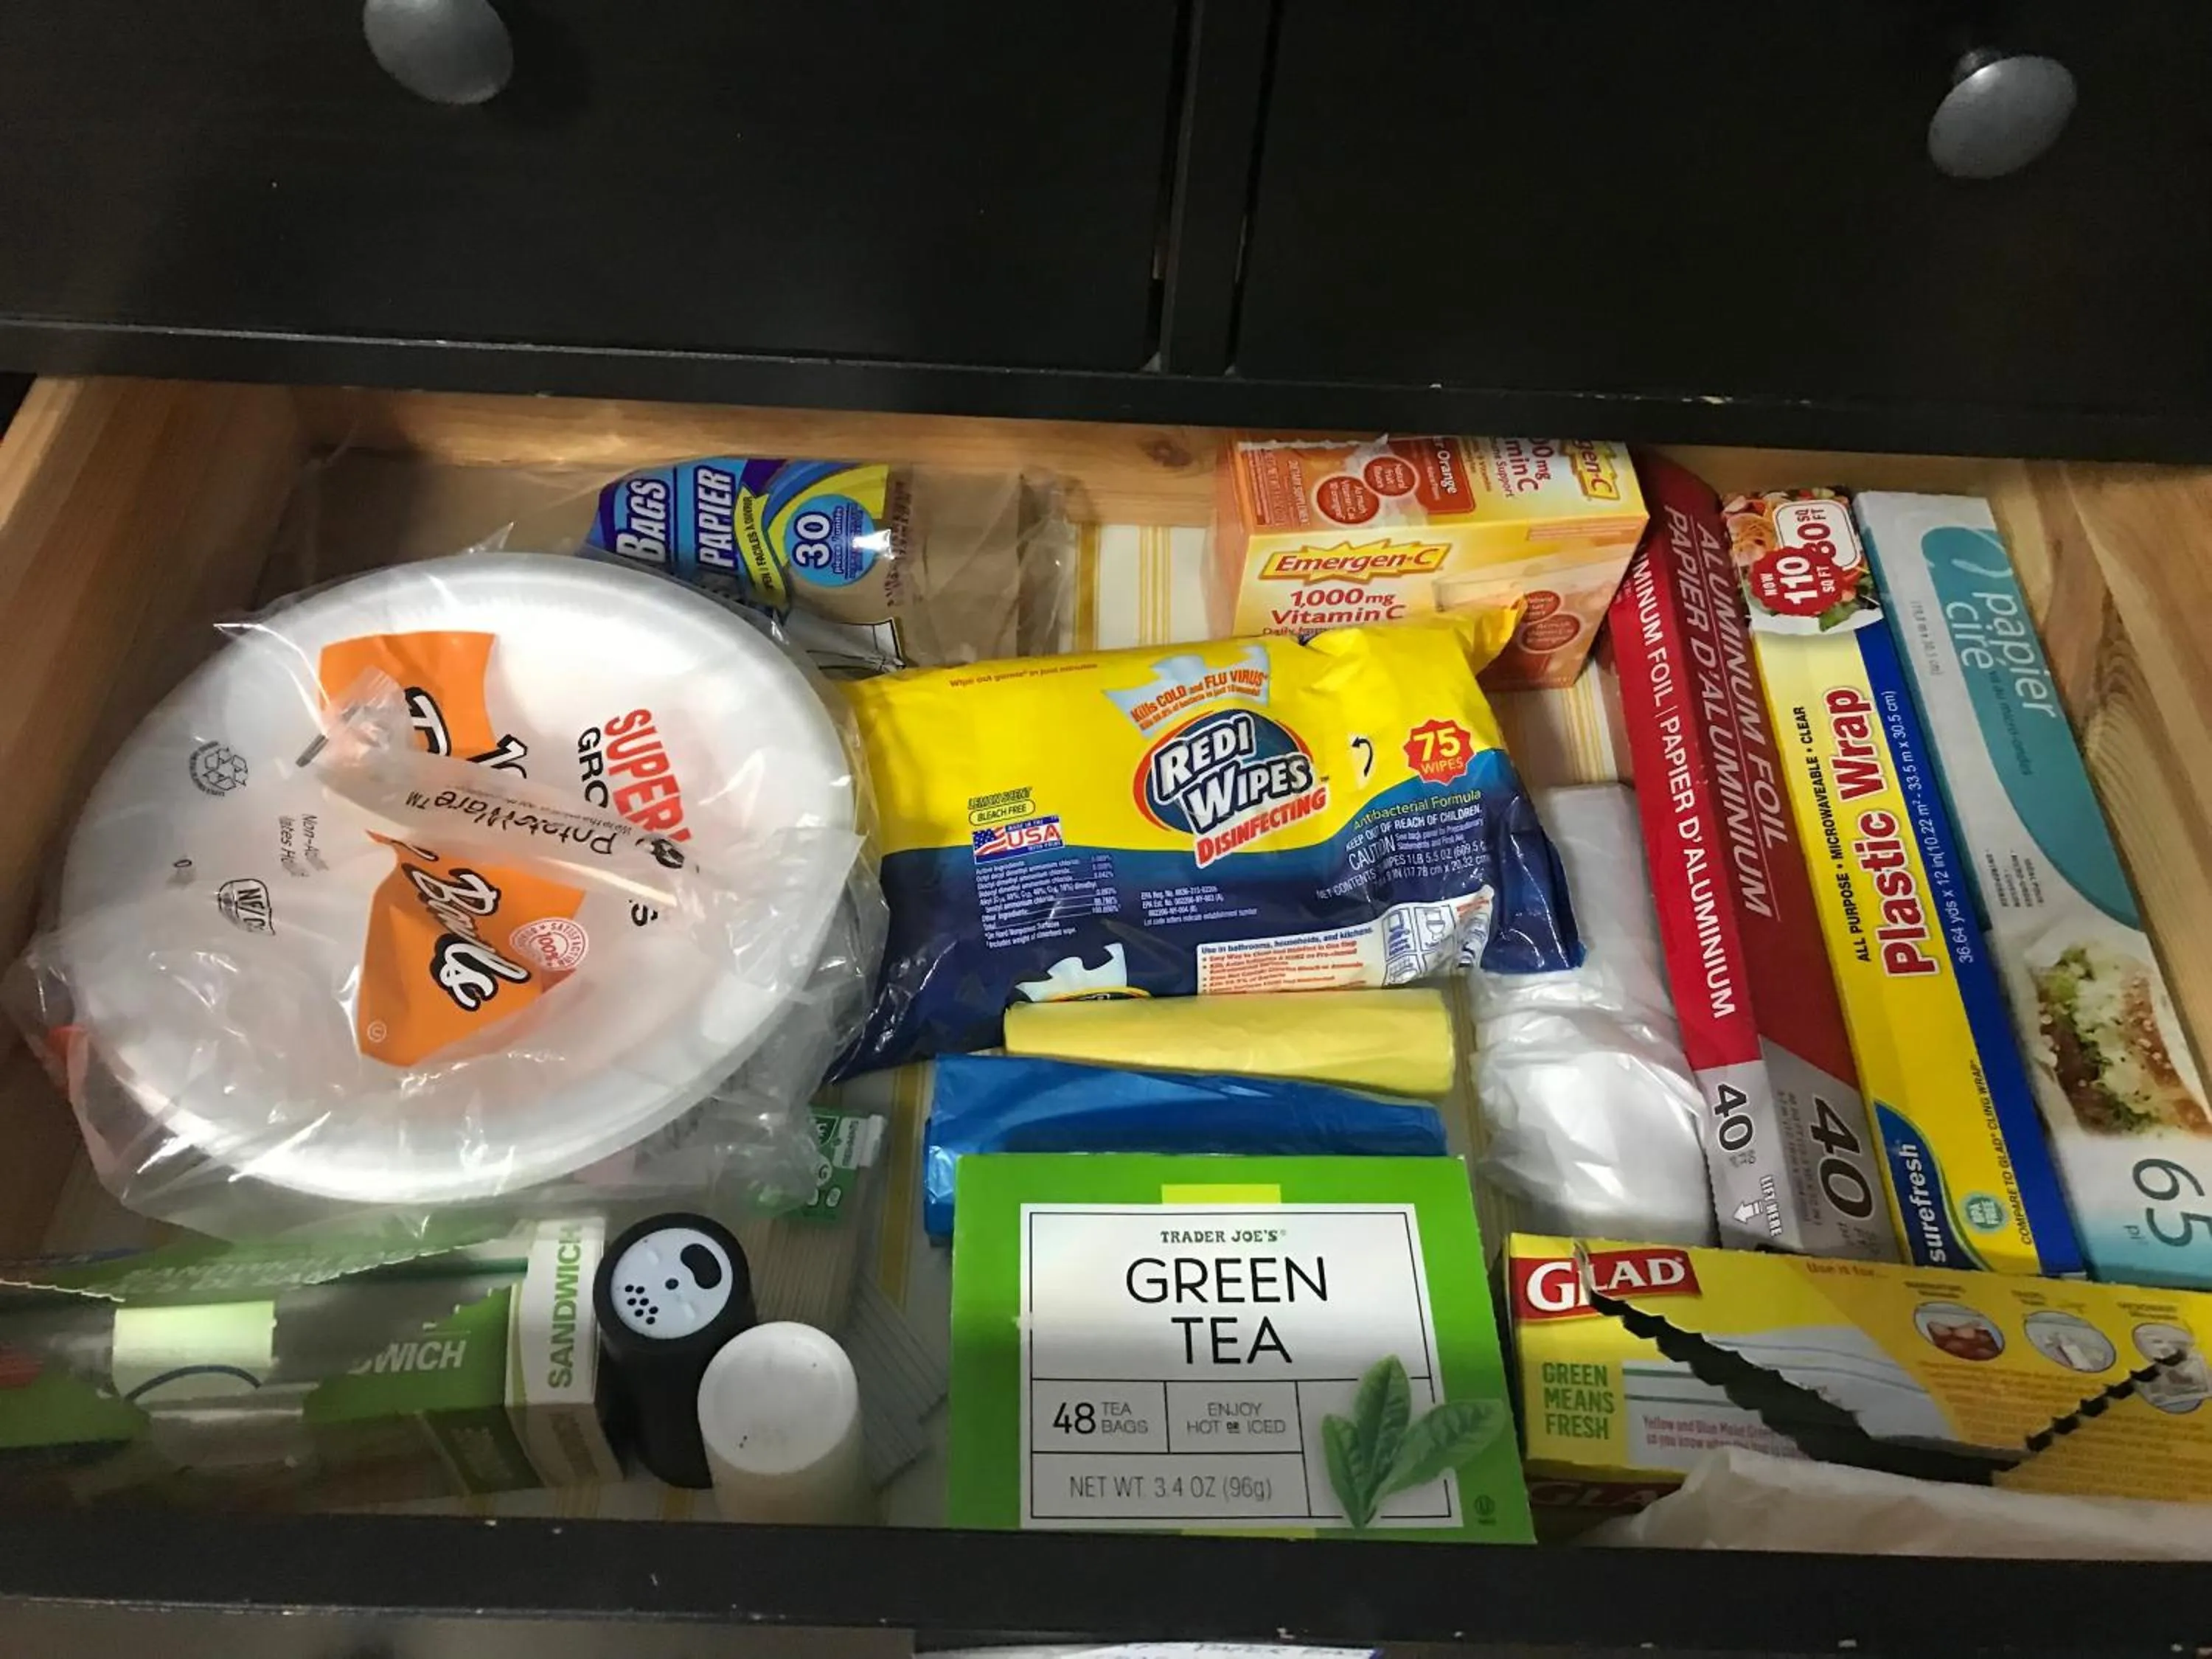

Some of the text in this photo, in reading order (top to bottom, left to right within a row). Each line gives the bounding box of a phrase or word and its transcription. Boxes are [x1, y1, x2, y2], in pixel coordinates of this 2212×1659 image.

[1437, 450, 1458, 494] Orange
[616, 477, 670, 562] BAGS
[698, 466, 736, 568] PAPIER
[795, 513, 831, 566] 30
[1275, 548, 1440, 574] Emergen-C
[1775, 556, 1818, 605] 110
[1816, 566, 1835, 593] SQ FT
[1290, 588, 1396, 608] 1,000 mg
[1760, 573, 1778, 596] NOW
[1271, 604, 1406, 625] Vitamin C
[1945, 600, 2007, 669] ciré
[1971, 592, 2057, 718] papier
[1131, 702, 1158, 722] Kills
[1156, 685, 1187, 707] COLD
[1204, 673, 1227, 689] FLU
[1647, 647, 1674, 707] FOIL
[1697, 522, 1789, 849] ALUMINUM FOIL
[1664, 505, 1774, 918] PAPIER D'ALUMINIUM
[1887, 714, 1907, 739] 30.5
[1160, 719, 1251, 797] REDI
[1413, 726, 1461, 761] 75
[1660, 714, 1695, 813] PAPIER
[1421, 757, 1464, 775] WIPES
[1902, 764, 1923, 790] 33.5
[978, 804, 1027, 822] BLEACH FREE
[1186, 758, 1308, 831] WIPES
[1354, 789, 1481, 830] Antibacterial Formula
[1007, 824, 1061, 848] USA
[1197, 787, 1326, 866] DISINFECTING
[1346, 834, 1363, 852] KEEP
[1380, 822, 1392, 833] OF
[1394, 815, 1425, 830] REACH
[1427, 813, 1438, 824] OF
[1792, 706, 1871, 962] ALL PURPOSE MICROWAVEABLE CLEAR
[1825, 689, 1935, 975] Plastic Wrap
[1316, 887, 1333, 900] NET
[1334, 868, 1376, 897] CONTENTS
[1934, 870, 1951, 886] 12
[1678, 815, 1736, 1019] D'ALUMINIUM
[1945, 900, 1965, 924] yds
[1950, 926, 1973, 964] 36.64
[1714, 1082, 1753, 1152] 40
[1983, 1096, 2000, 1131] CLING
[1809, 1097, 1874, 1219] 40
[2002, 1170, 2015, 1187] TO
[1760, 1175, 1783, 1237] LIFT HERE
[1899, 1144, 1947, 1263] surefresh
[2007, 1190, 2034, 1246] COMPARE
[2132, 1158, 2212, 1247] 65
[1161, 1231, 1225, 1243] TRADER
[1126, 1256, 1328, 1304] GREEN
[1526, 1257, 1686, 1312] GLAD
[548, 1225, 583, 1389] SANDWICH
[1171, 1315, 1293, 1365] TEA
[1542, 1361, 1608, 1388] GREEN
[1053, 1401, 1132, 1435] 48 TEA
[1207, 1402, 1261, 1417] ENJOY
[1543, 1388, 1615, 1415] MEANS
[1102, 1419, 1149, 1434] BAGS
[1186, 1419, 1286, 1434] HOT OR ICED
[1544, 1413, 1609, 1441] FRESH
[1070, 1476, 1107, 1498] NET
[1154, 1476, 1183, 1498] 3.4
[1192, 1476, 1216, 1498] OZ
[1222, 1476, 1272, 1501] (96g)
